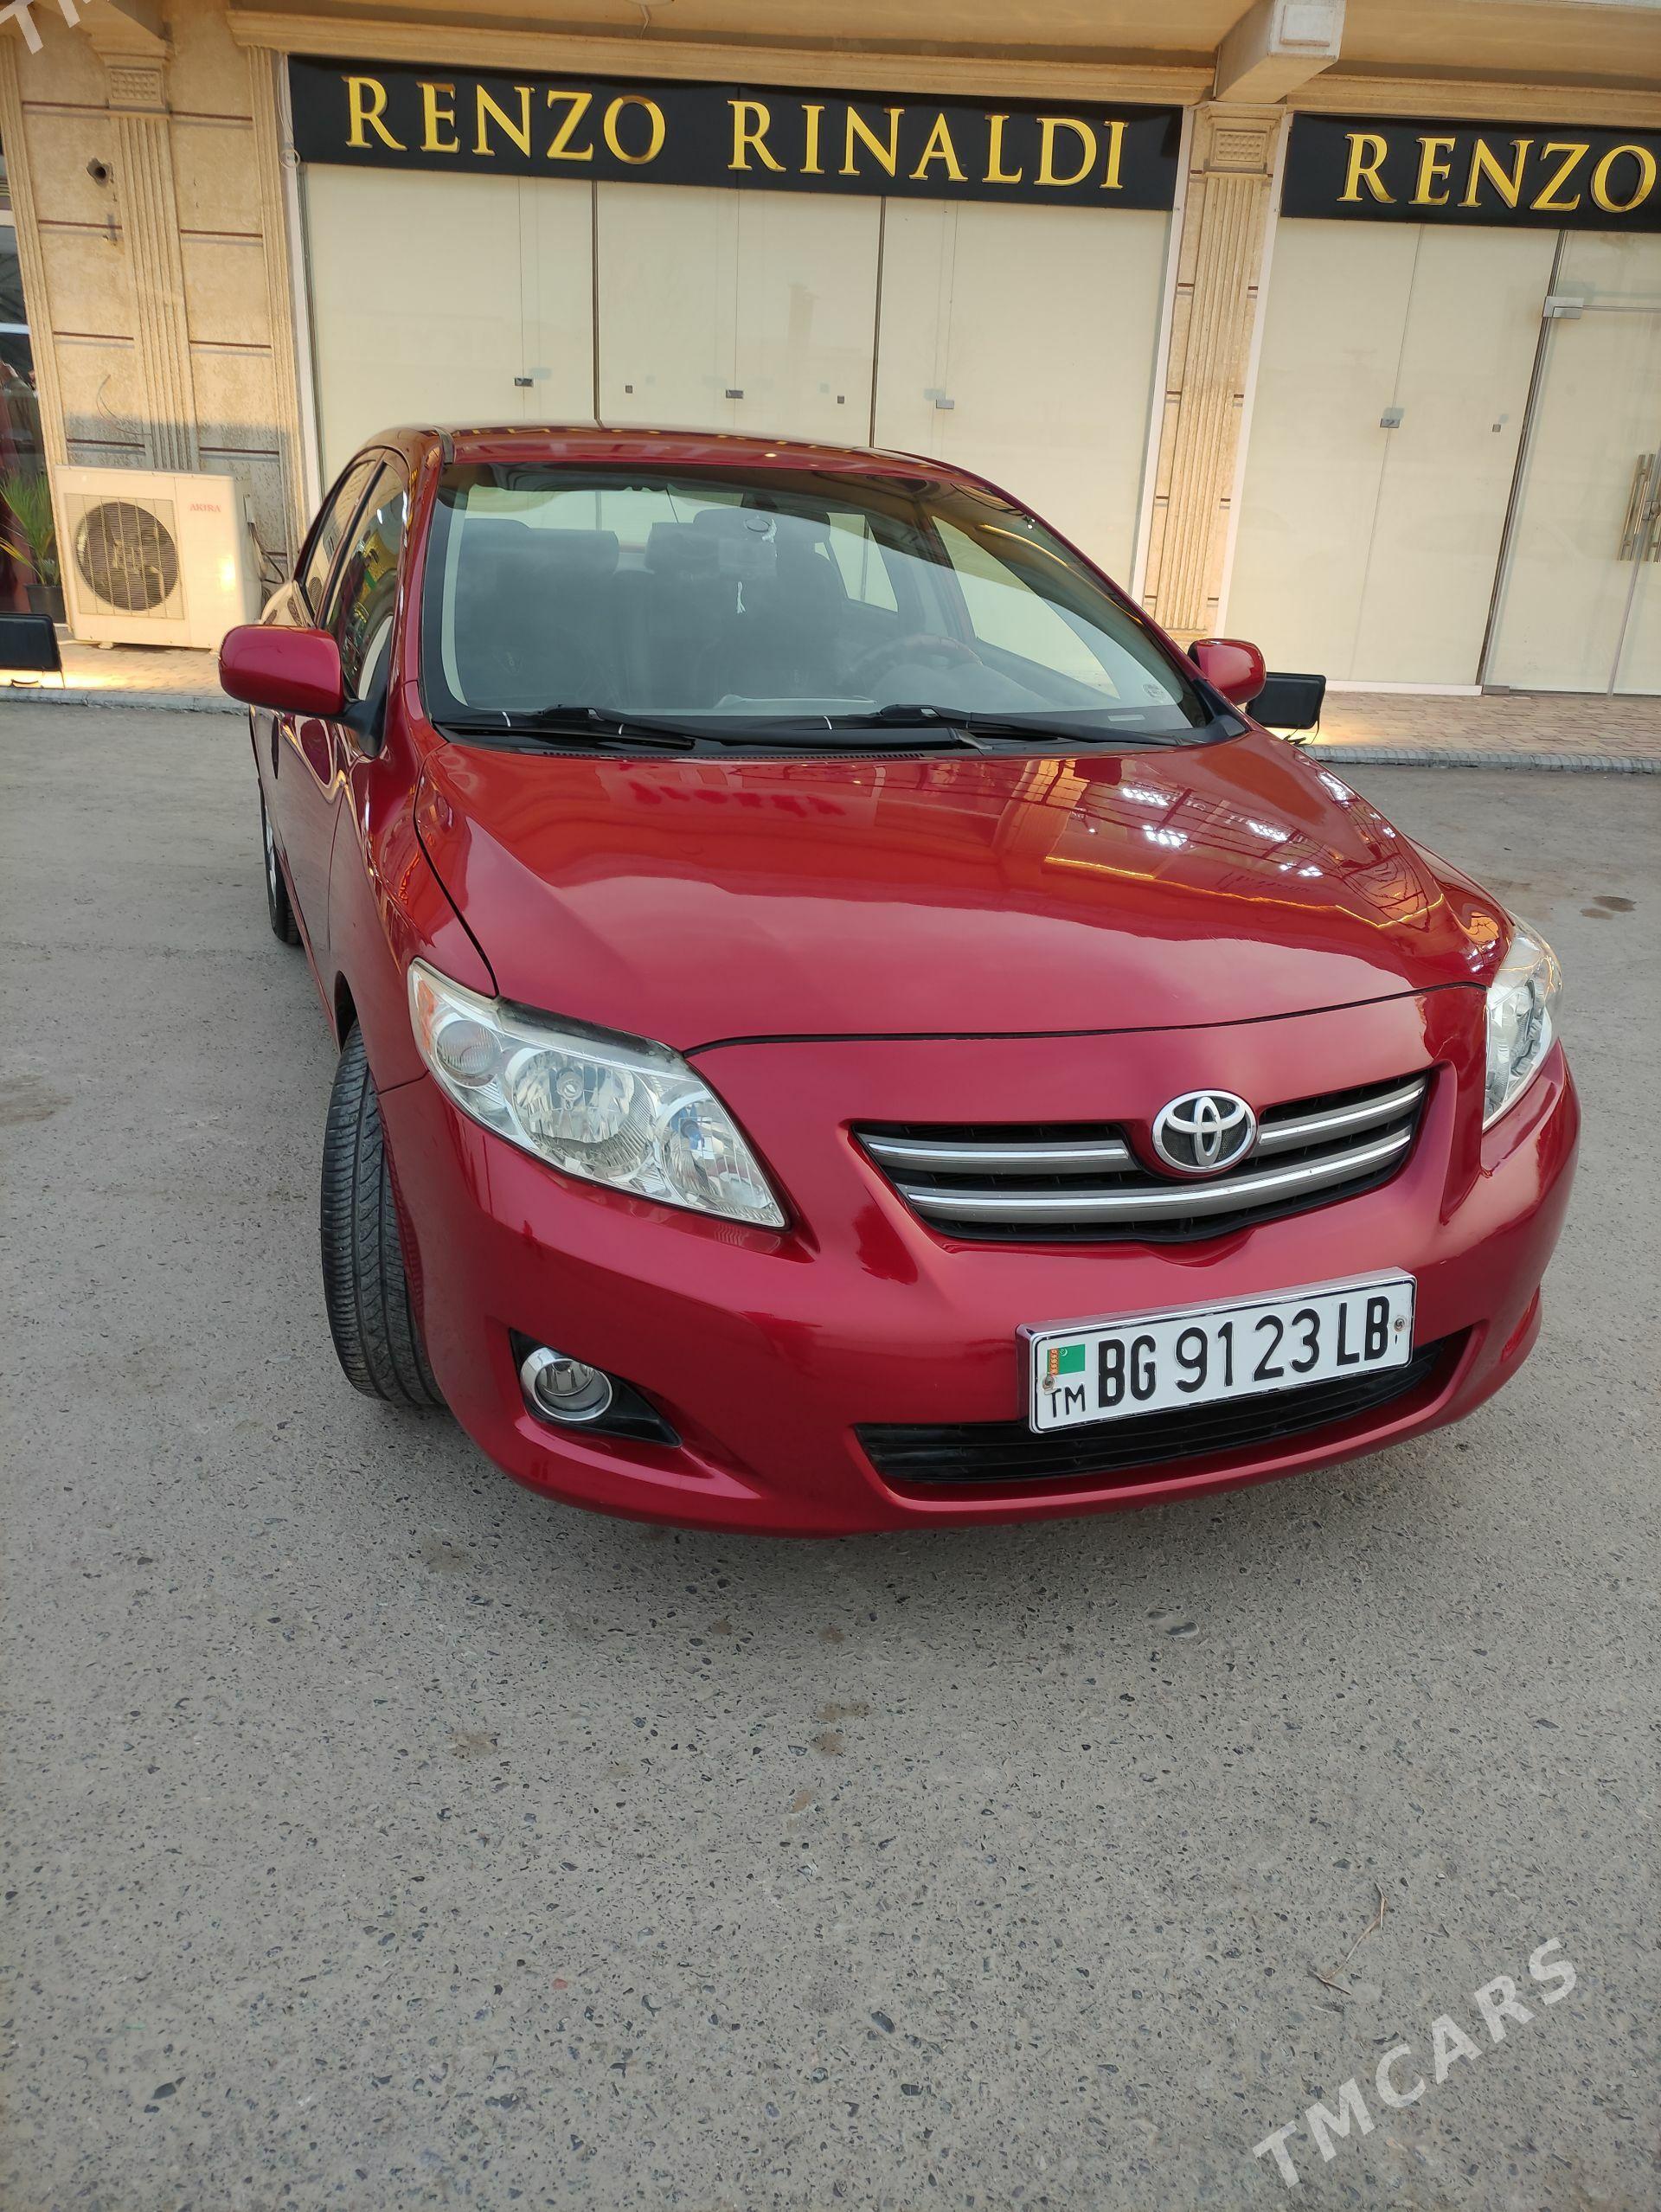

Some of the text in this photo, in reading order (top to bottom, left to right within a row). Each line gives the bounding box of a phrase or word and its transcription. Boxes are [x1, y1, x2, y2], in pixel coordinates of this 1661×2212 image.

[343, 75, 1128, 189] RENZO RINALDI
[1337, 133, 1658, 213] RENZO
[189, 503, 221, 513] AKIRA
[1049, 1384, 1087, 1419] TM
